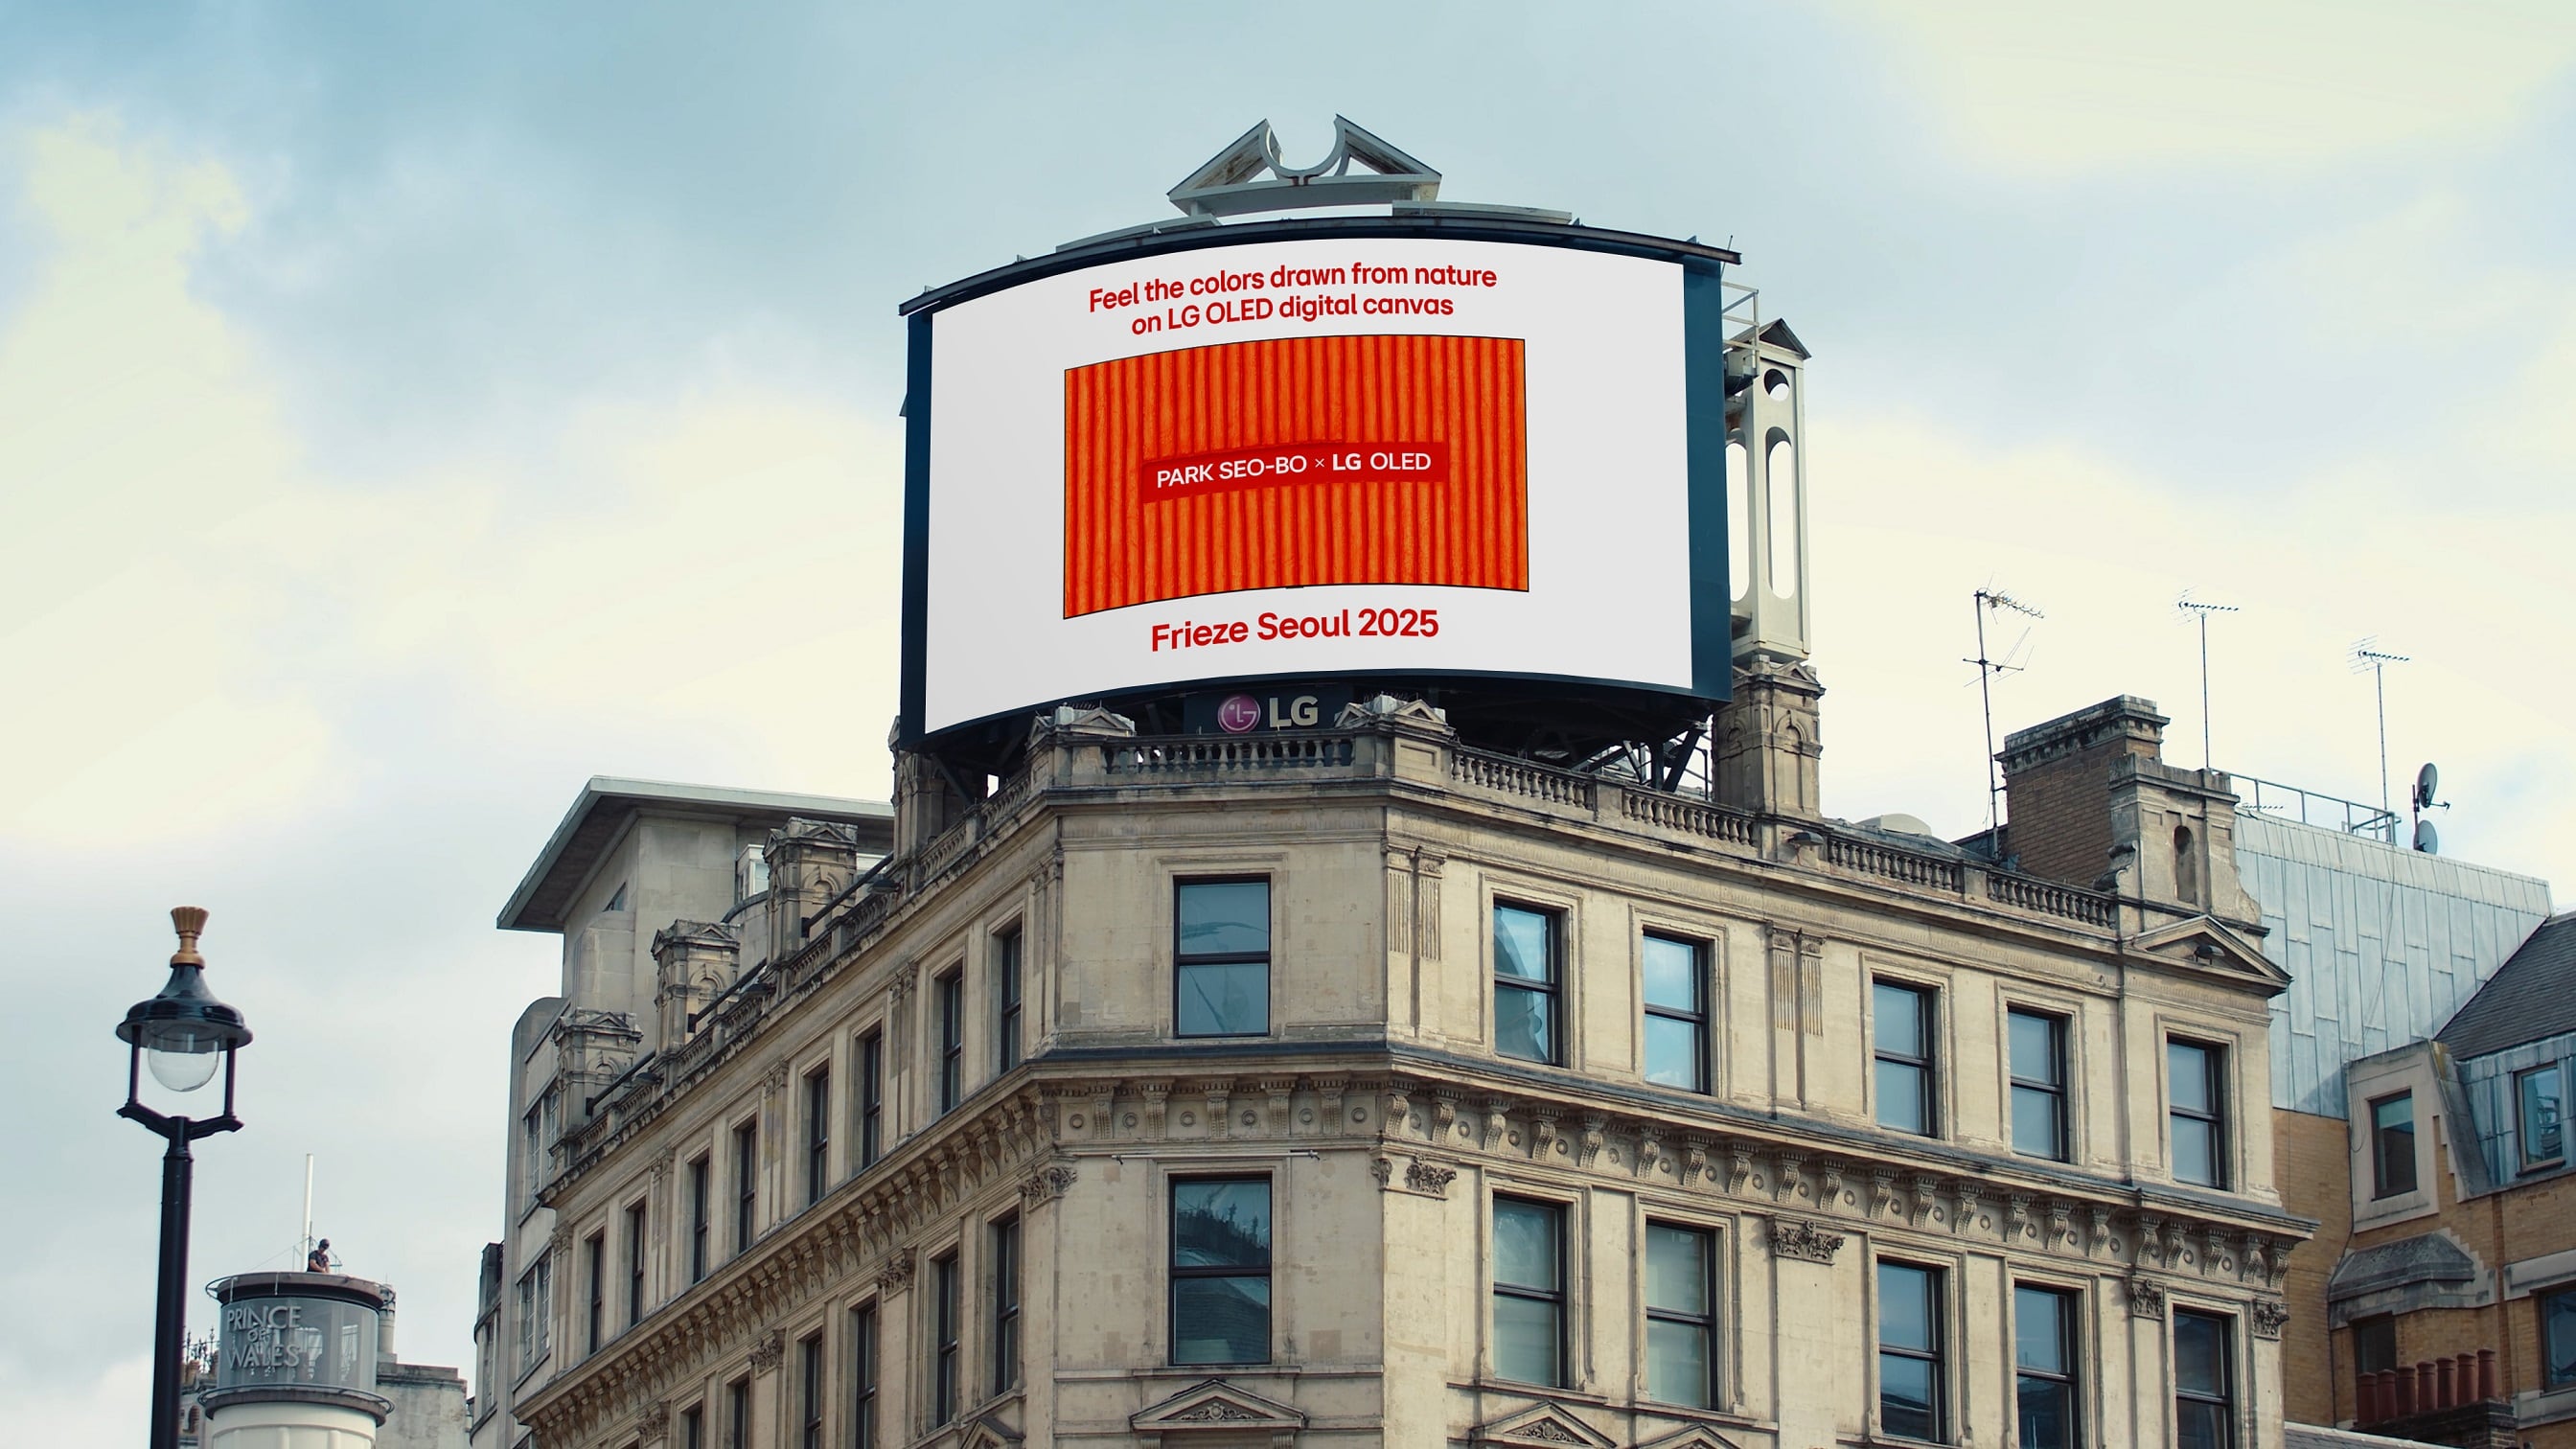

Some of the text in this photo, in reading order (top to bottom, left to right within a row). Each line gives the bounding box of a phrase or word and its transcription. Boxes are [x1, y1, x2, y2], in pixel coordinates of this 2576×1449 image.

[1089, 262, 1498, 313] Feel the colors drawn from nature
[1131, 292, 1455, 335] on LG OLED digital canvas
[1157, 463, 1214, 489] PARK
[1218, 454, 1307, 480] SEO-BO
[1332, 452, 1362, 472] LG
[1369, 451, 1432, 471] OLED
[1151, 608, 1439, 653] Frieze Seoul 2025
[1269, 696, 1319, 728] LG
[226, 1305, 302, 1331] PRINCE
[225, 1344, 301, 1369] WALES
